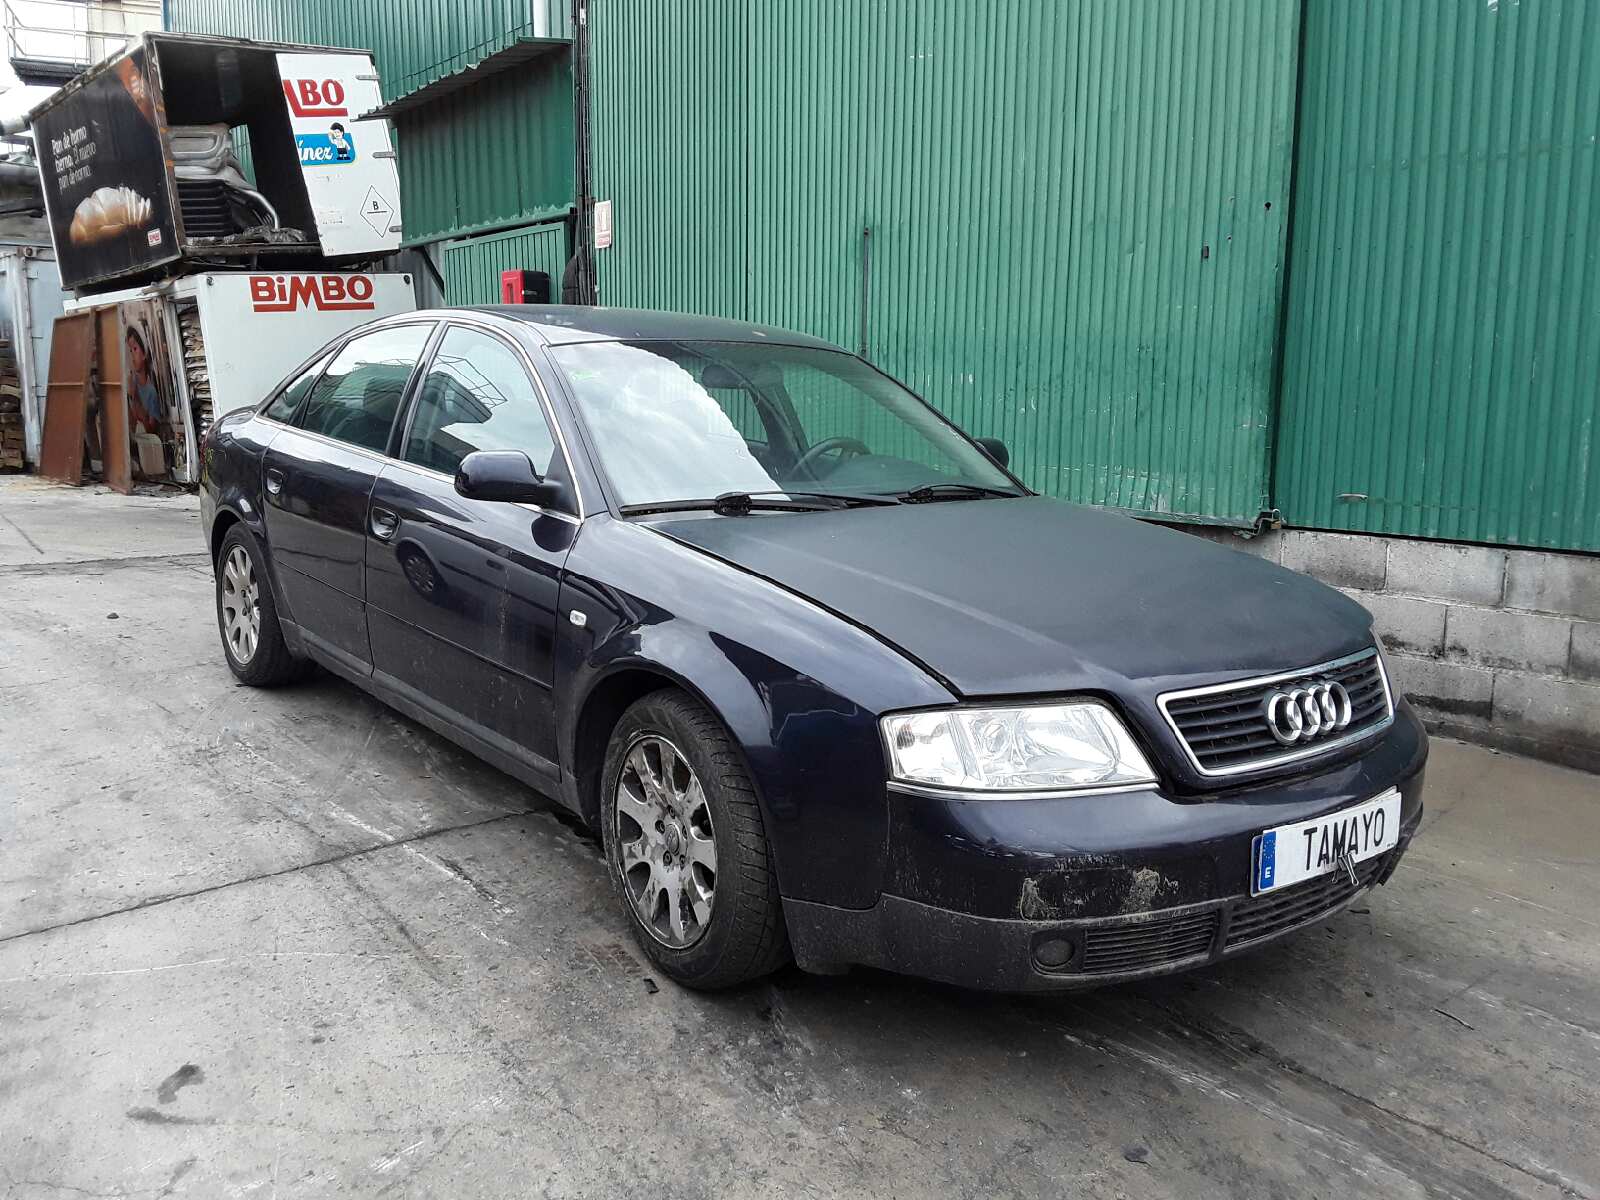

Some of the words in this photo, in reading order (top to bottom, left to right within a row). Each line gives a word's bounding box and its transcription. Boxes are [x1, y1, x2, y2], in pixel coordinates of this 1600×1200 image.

[51, 139, 63, 155] Pan
[63, 132, 71, 149] de
[372, 201, 379, 211] B
[1303, 808, 1385, 871] TAMAYO
[1264, 866, 1272, 879] E
